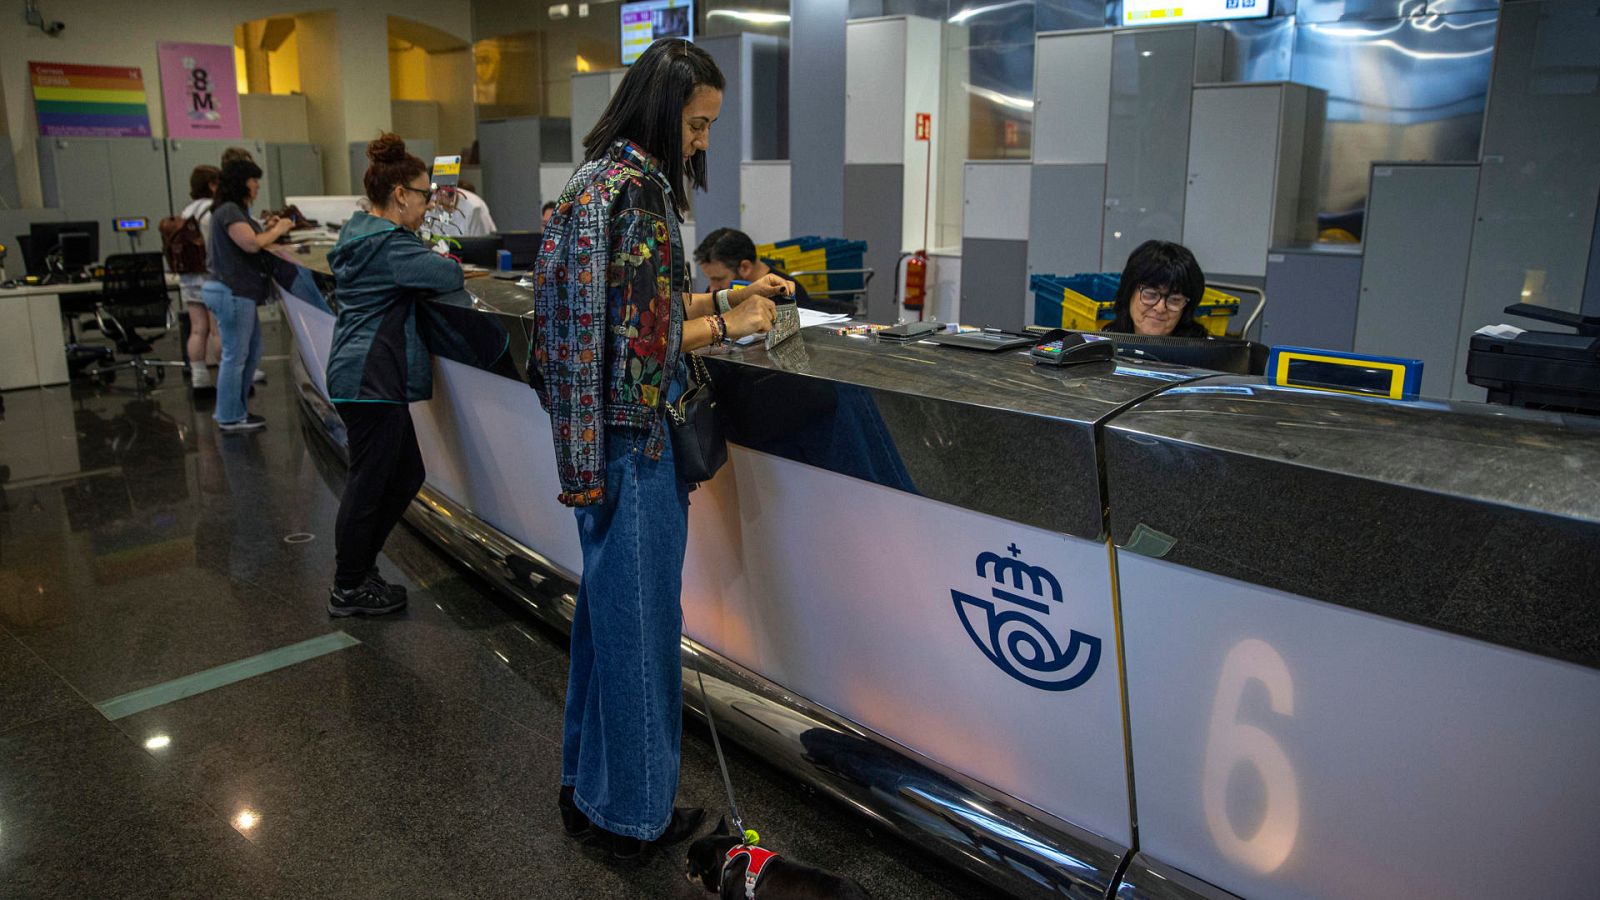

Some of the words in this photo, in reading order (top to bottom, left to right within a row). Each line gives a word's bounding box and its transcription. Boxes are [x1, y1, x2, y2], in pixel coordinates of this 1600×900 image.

[192, 68, 208, 91] 8
[192, 92, 214, 112] M
[1203, 638, 1299, 874] 6
